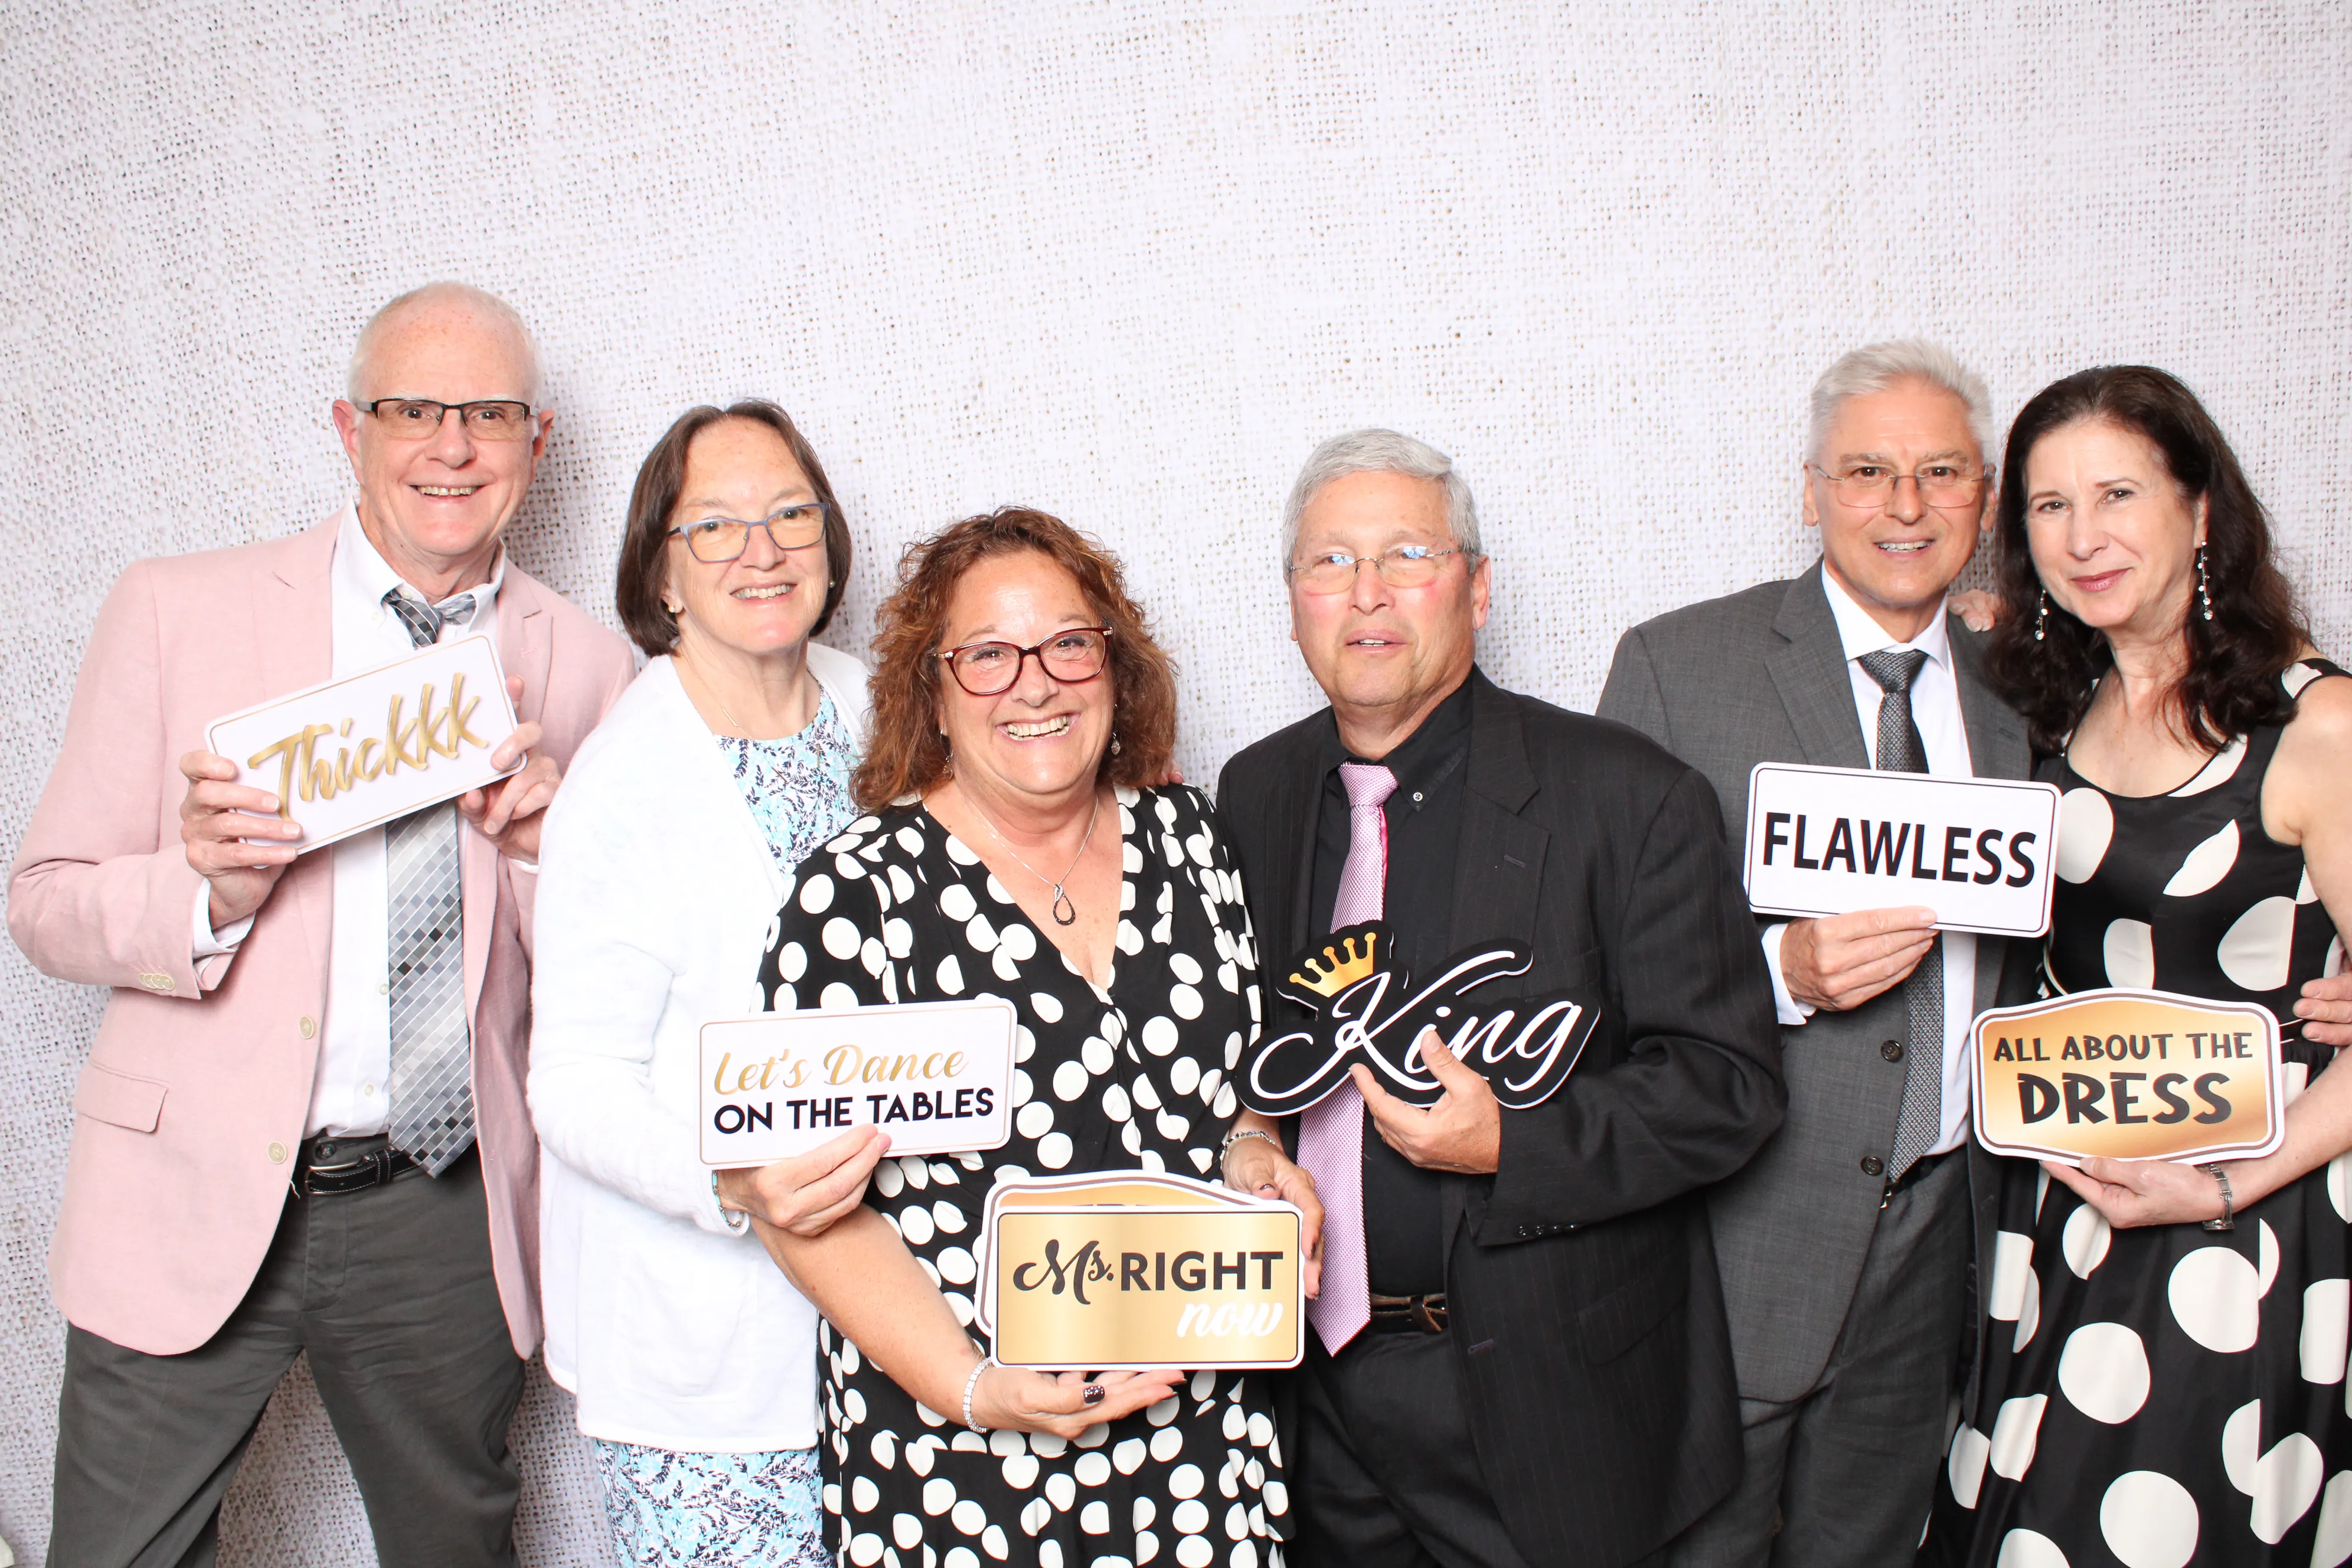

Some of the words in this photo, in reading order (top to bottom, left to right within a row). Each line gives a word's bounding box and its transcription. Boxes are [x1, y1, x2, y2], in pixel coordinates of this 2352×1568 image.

[247, 672, 488, 822] Thickkk
[1763, 812, 2036, 888] FLAWLESS
[1250, 950, 1582, 1100] King
[1993, 1037, 2050, 1061] ALL
[2061, 1033, 2173, 1060] ABOUT
[2186, 1033, 2253, 1059] THE
[714, 1048, 812, 1095] Let's
[823, 1044, 969, 1086] Dance
[714, 1102, 773, 1134] ON
[786, 1097, 852, 1129] THE
[867, 1087, 994, 1124] TABLES
[2017, 1072, 2232, 1125] DRESS
[1012, 1239, 1114, 1305] Ms.
[1121, 1251, 1283, 1291] RIGHT
[1177, 1302, 1284, 1338] now
